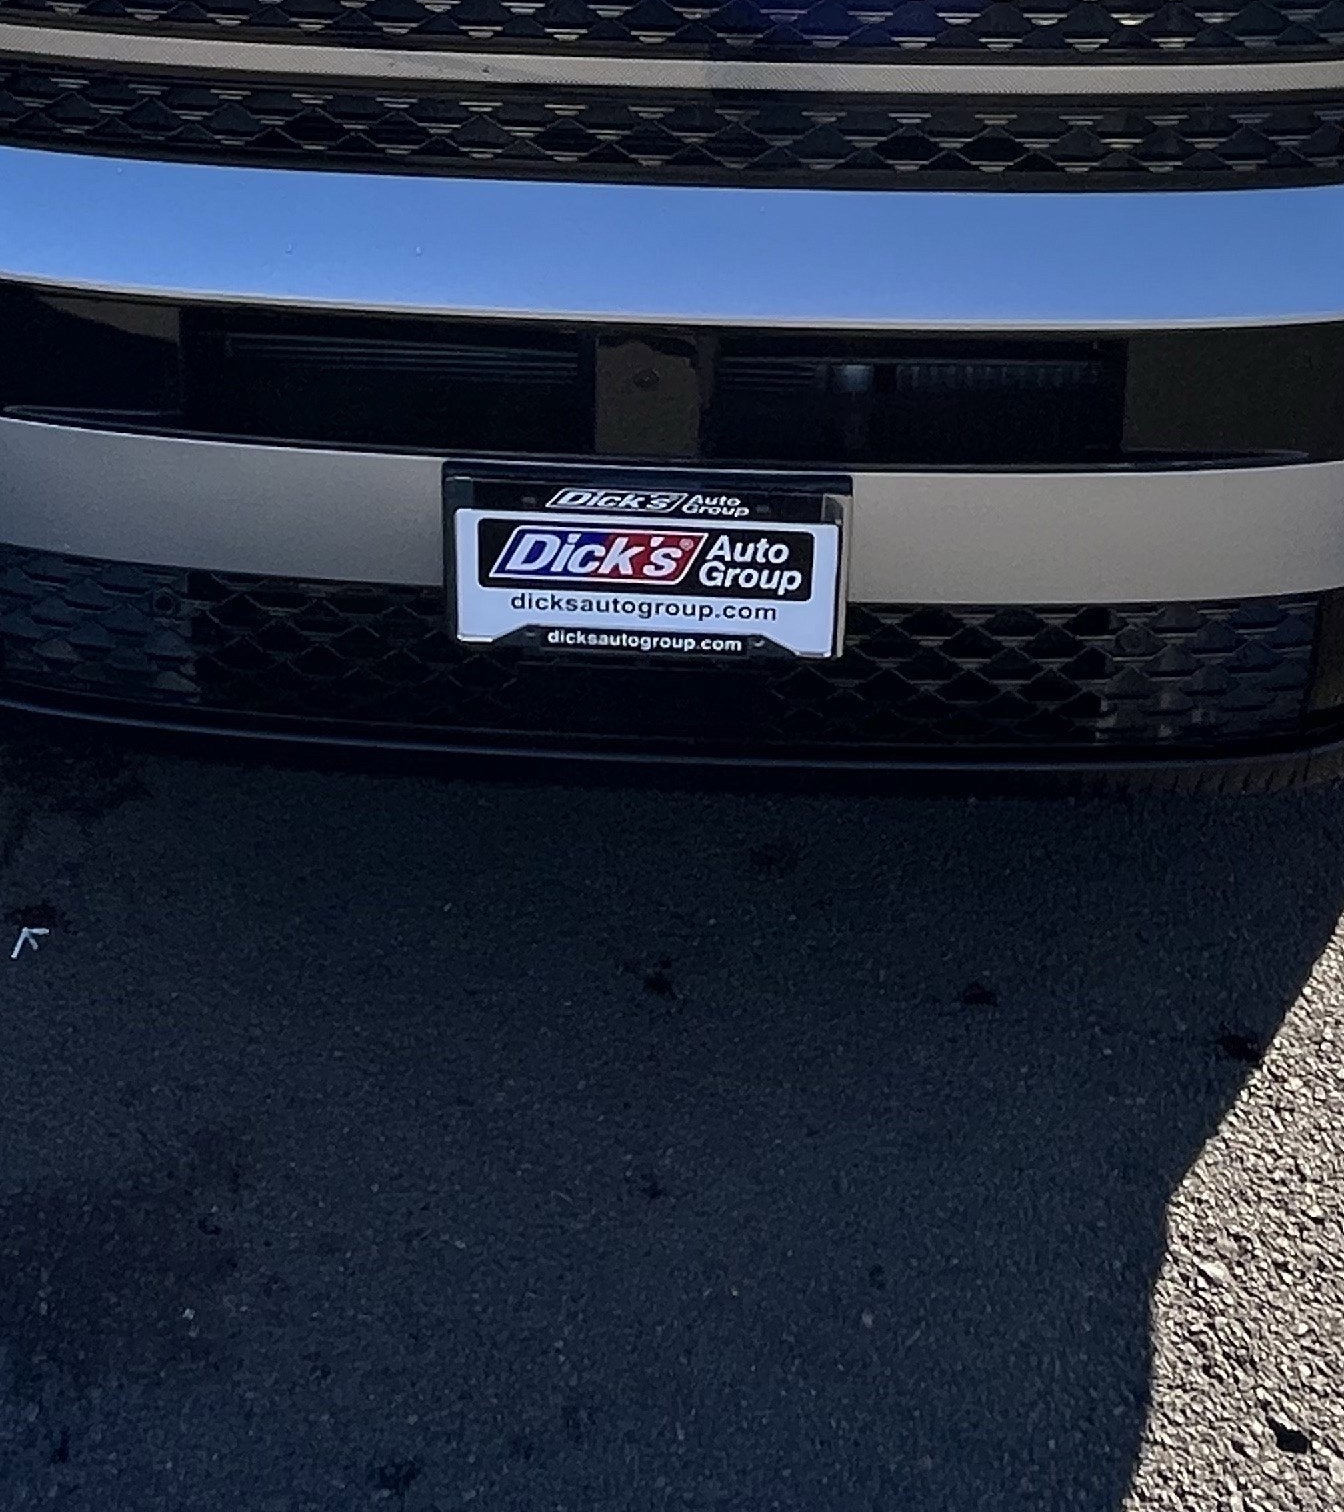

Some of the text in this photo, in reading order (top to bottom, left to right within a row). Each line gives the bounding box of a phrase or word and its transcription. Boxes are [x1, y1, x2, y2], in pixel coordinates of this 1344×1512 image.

[556, 490, 742, 510] Dick's Auto
[682, 504, 751, 518] Group
[505, 533, 791, 578] Dick's Auto
[698, 561, 803, 596] Group
[510, 591, 778, 622] dicksautogroup.com
[546, 629, 743, 653] dicksautogroup.com
